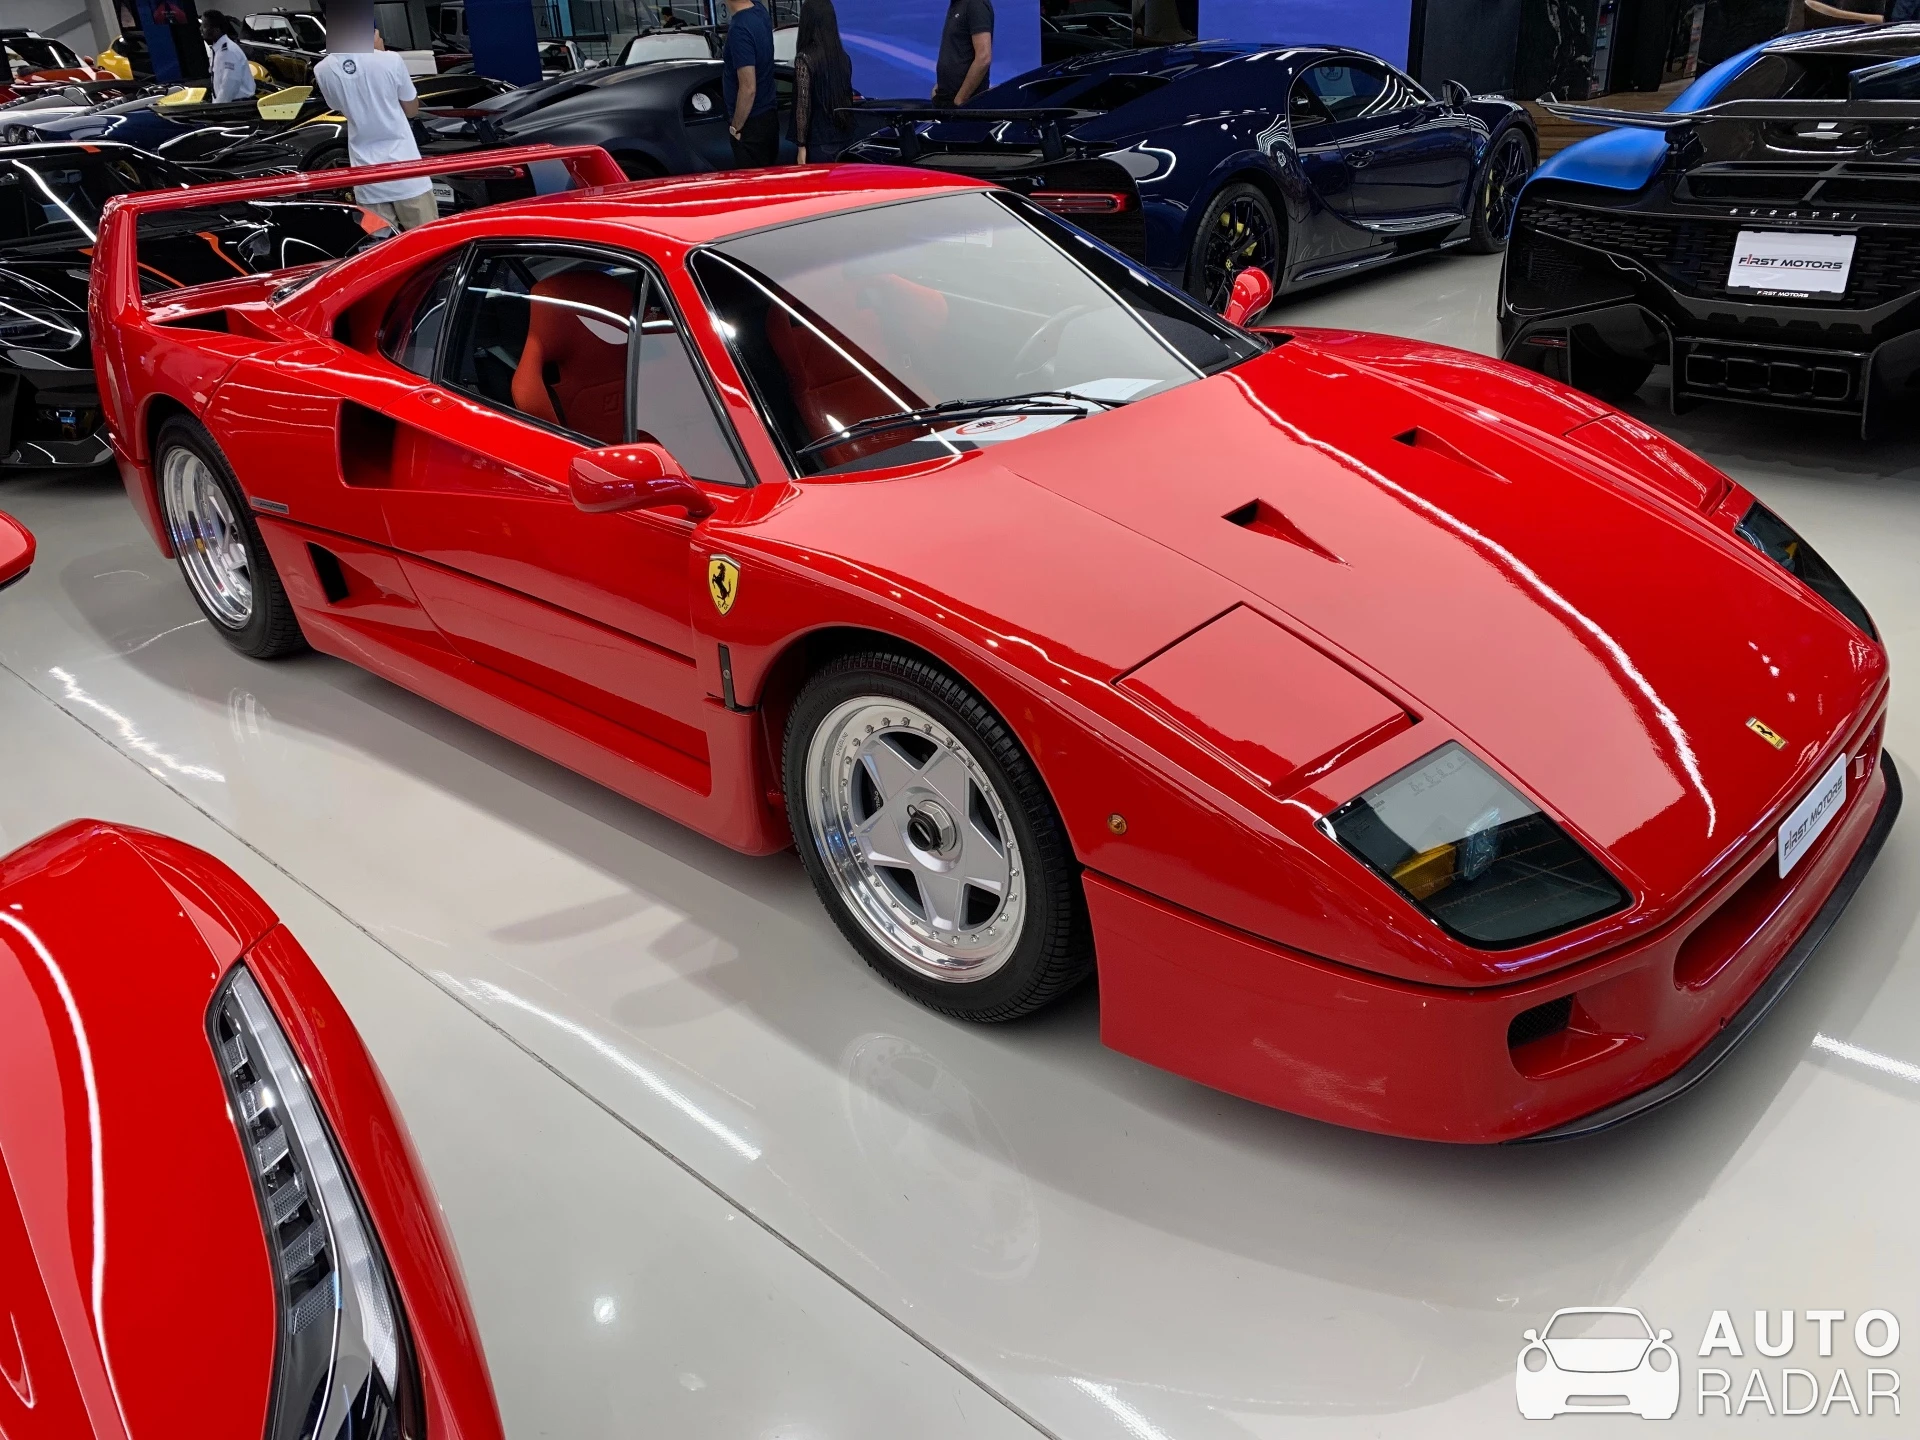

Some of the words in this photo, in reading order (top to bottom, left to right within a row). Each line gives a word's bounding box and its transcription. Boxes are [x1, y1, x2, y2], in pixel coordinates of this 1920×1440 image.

[1729, 208, 1857, 221] BUGATTI
[1780, 259, 1843, 270] MOTORS
[1809, 776, 1843, 826] MOTORS
